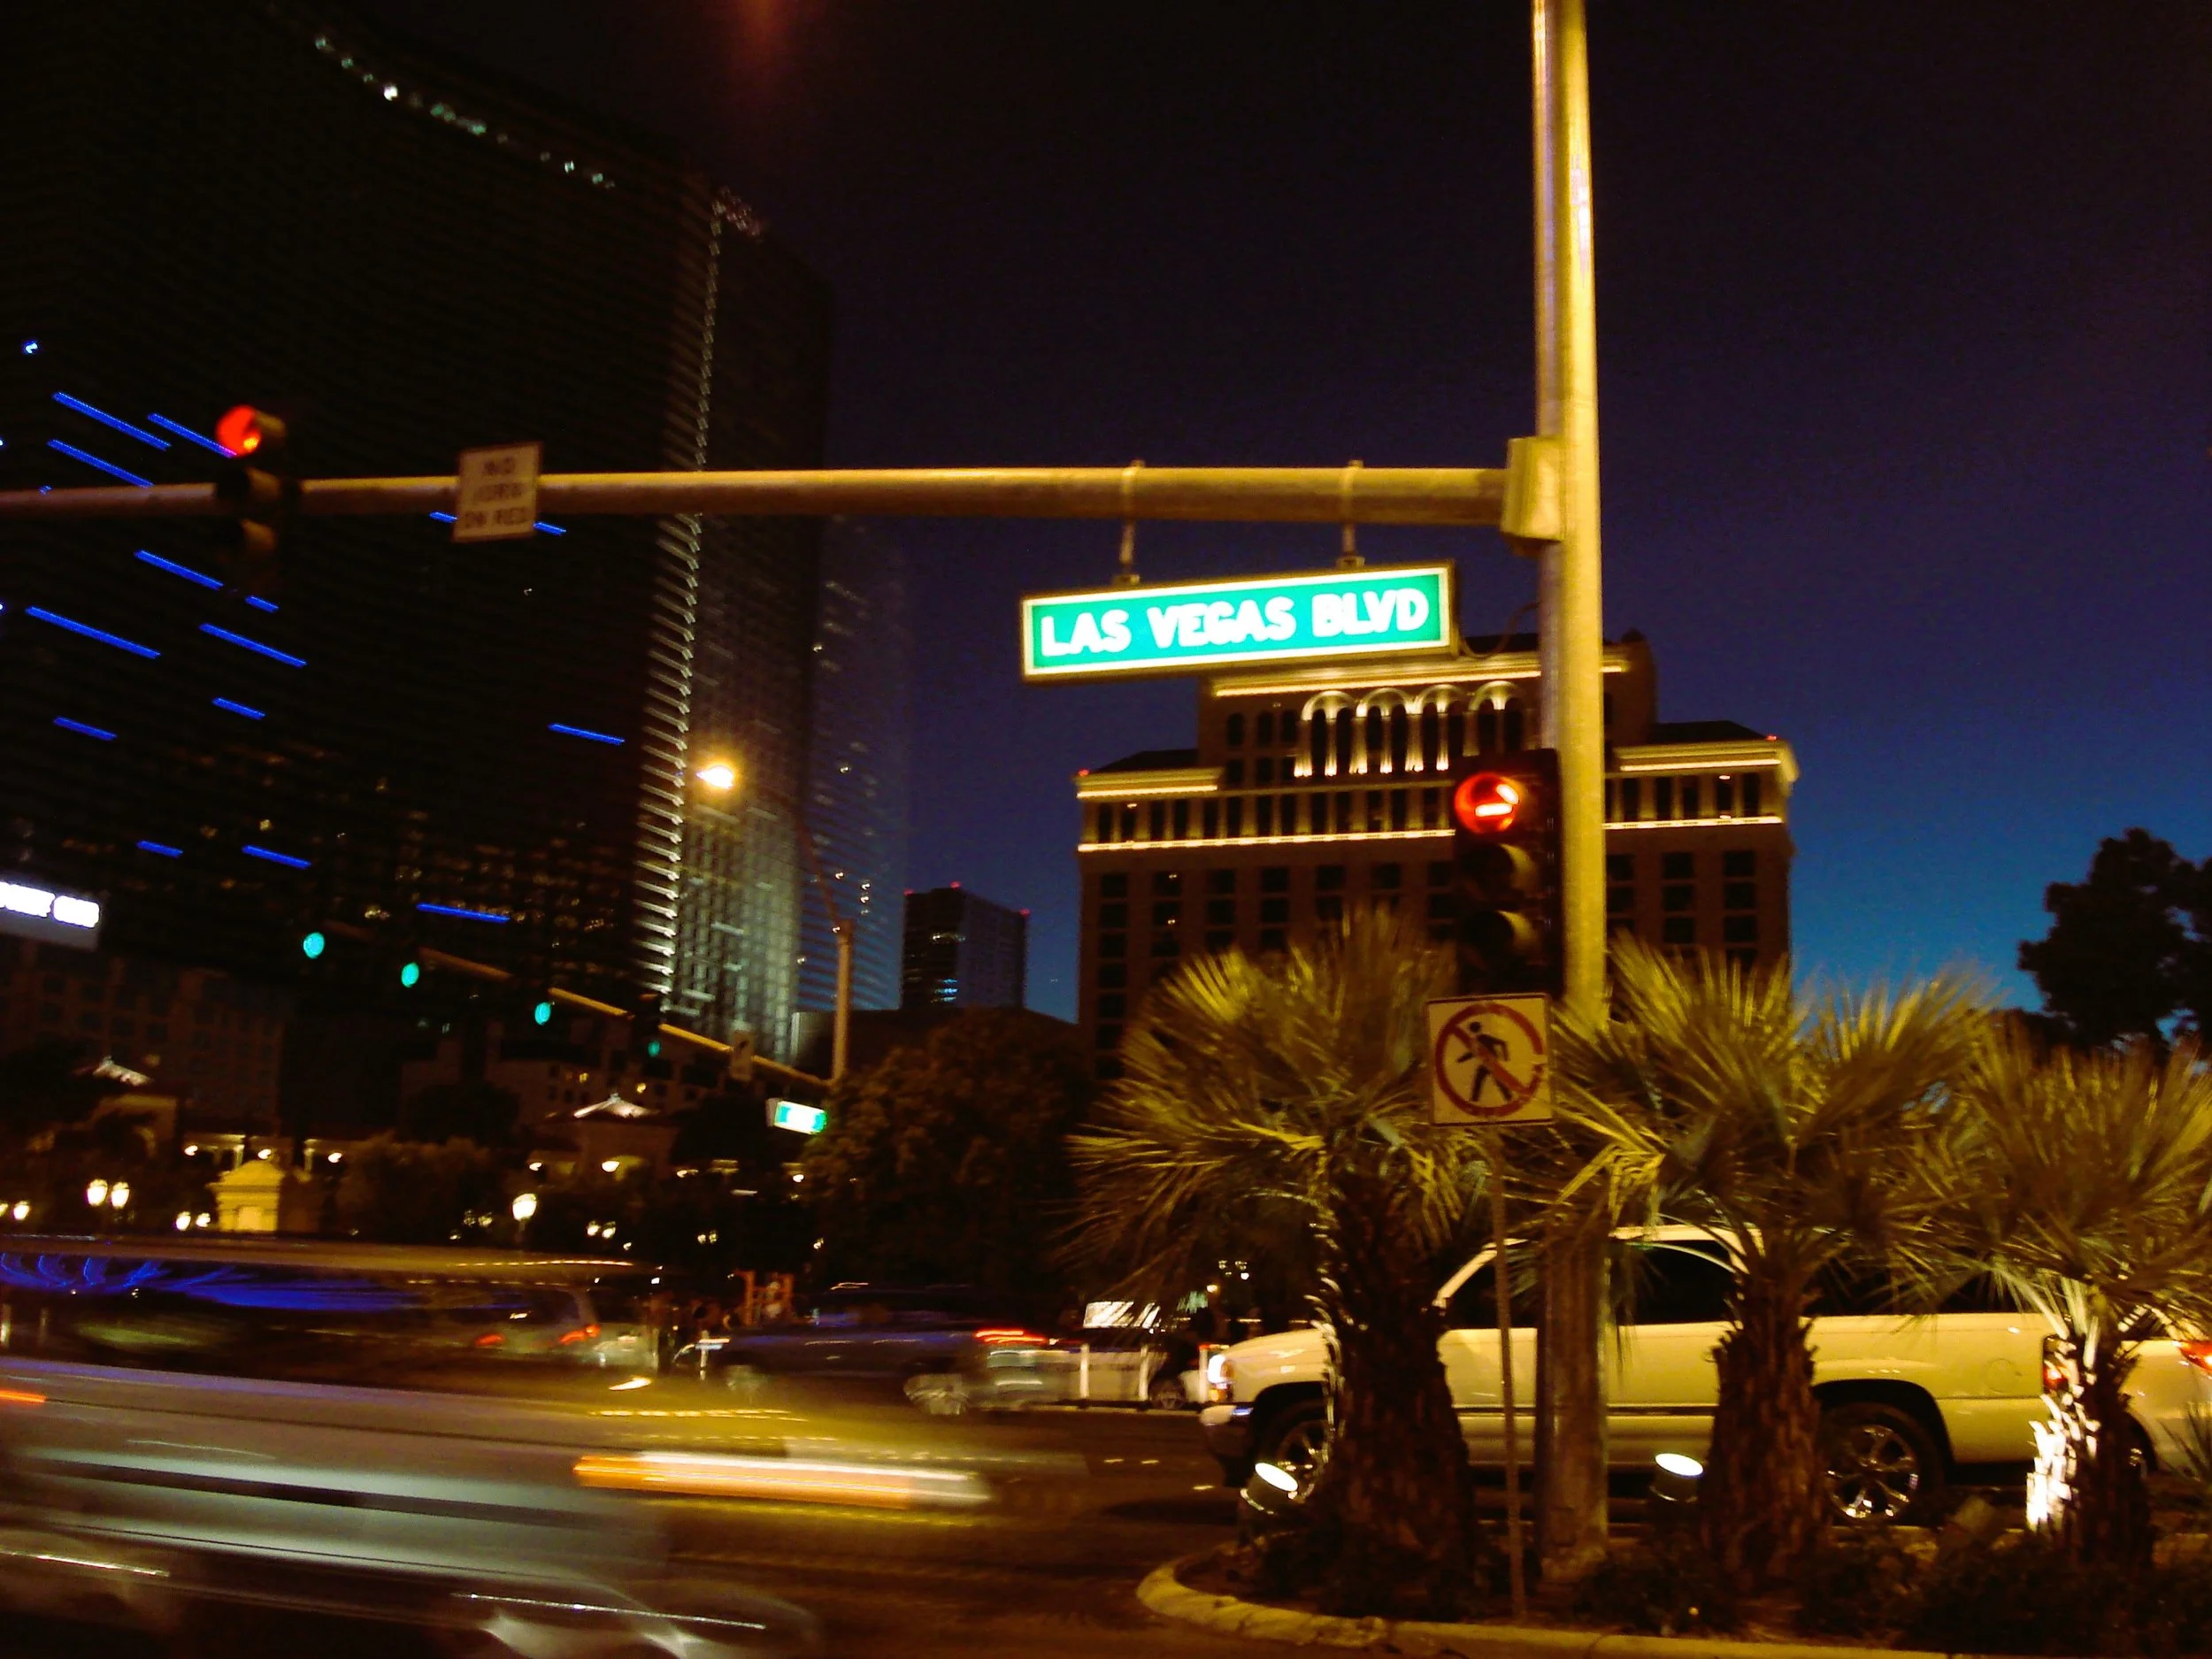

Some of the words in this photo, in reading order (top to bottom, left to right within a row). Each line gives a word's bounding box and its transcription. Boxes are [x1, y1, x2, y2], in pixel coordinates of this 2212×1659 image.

[1041, 611, 1131, 657] LAS
[1148, 598, 1296, 648] VEGAS
[1313, 588, 1429, 637] BLVD
